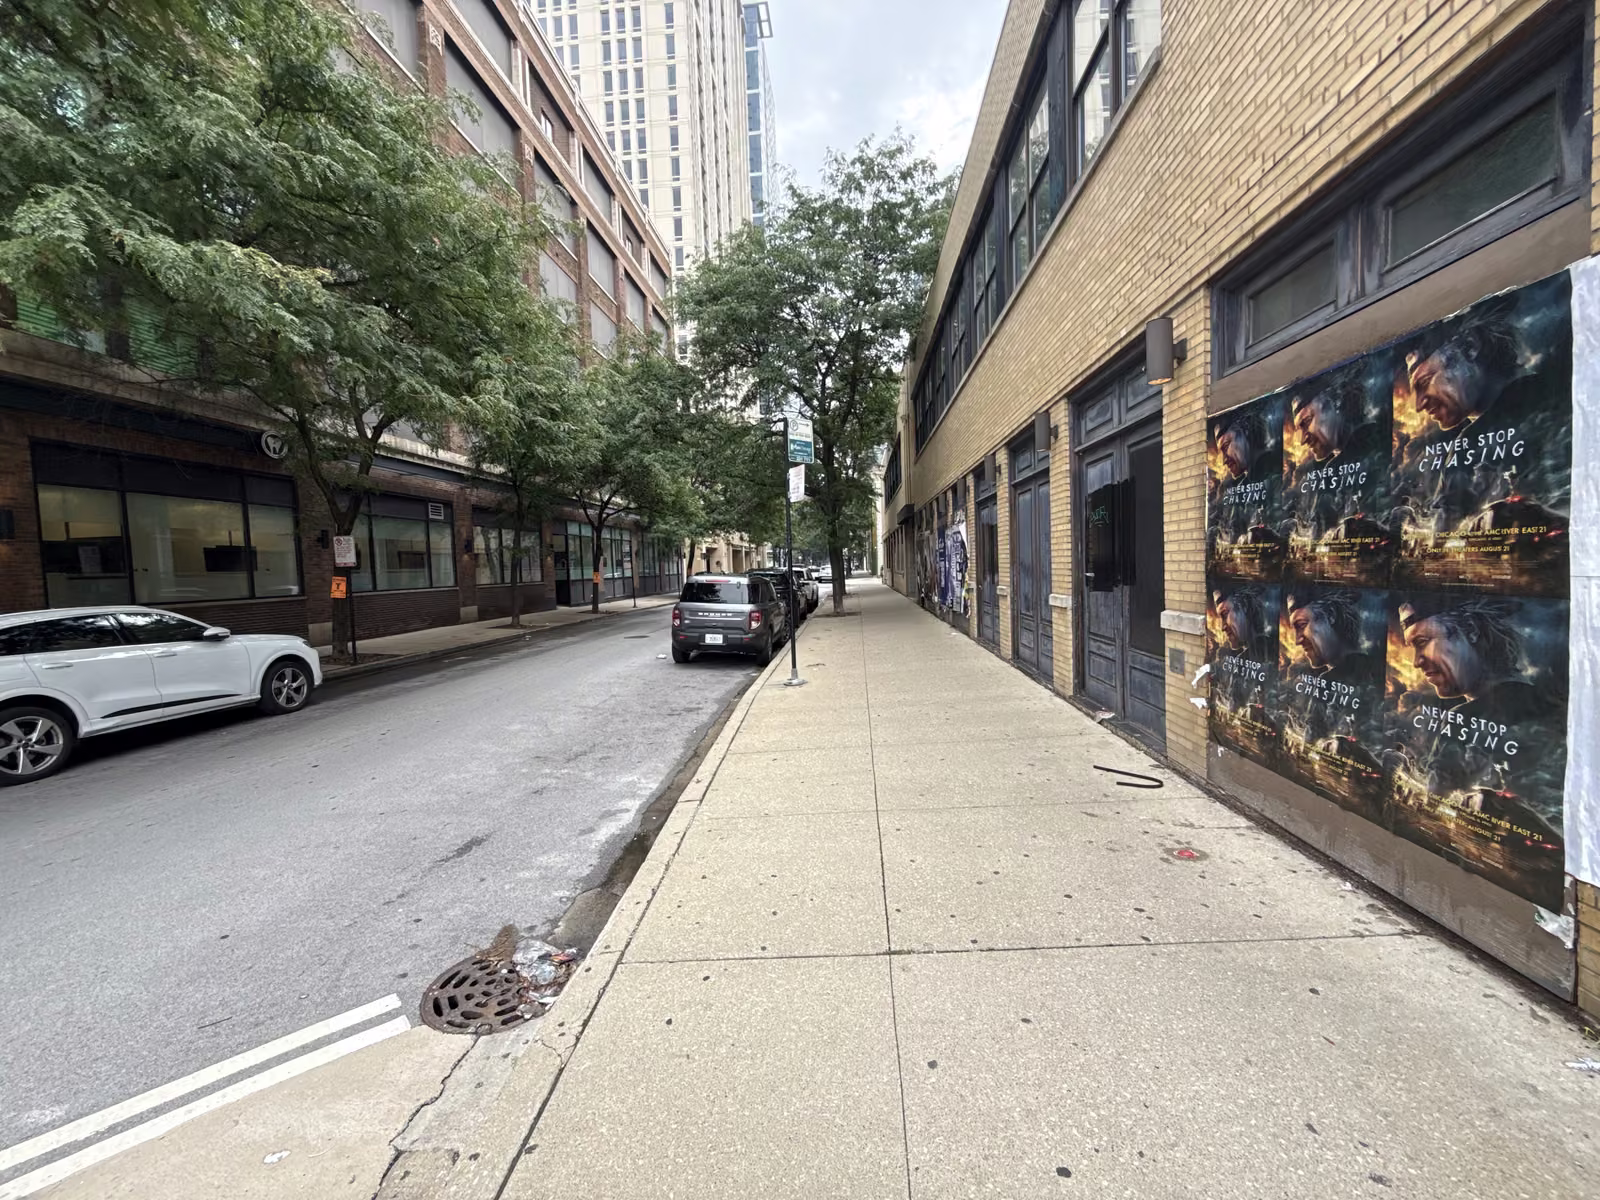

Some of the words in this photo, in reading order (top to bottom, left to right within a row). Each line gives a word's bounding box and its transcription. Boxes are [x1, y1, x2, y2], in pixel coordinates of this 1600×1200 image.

[1425, 438, 1469, 456] NEVER
[1477, 428, 1515, 446] STOP
[1419, 440, 1525, 472] CHASING
[1307, 468, 1333, 480] NEVER
[1338, 462, 1361, 475] STOP
[1226, 485, 1245, 495] NEVER
[1301, 472, 1367, 493] CHASING
[1223, 490, 1267, 505] CHASING
[1222, 662, 1266, 682] CHASING
[1245, 660, 1262, 670] STOP
[1301, 674, 1327, 689] NEVER
[1331, 681, 1355, 695] STOP
[1295, 682, 1360, 709] CHASING
[1421, 704, 1464, 725] NEVER
[1470, 717, 1507, 736] STOP
[1413, 715, 1519, 755] CHASING
[1513, 825, 1531, 837] EAST
[1533, 833, 1543, 842] 21
